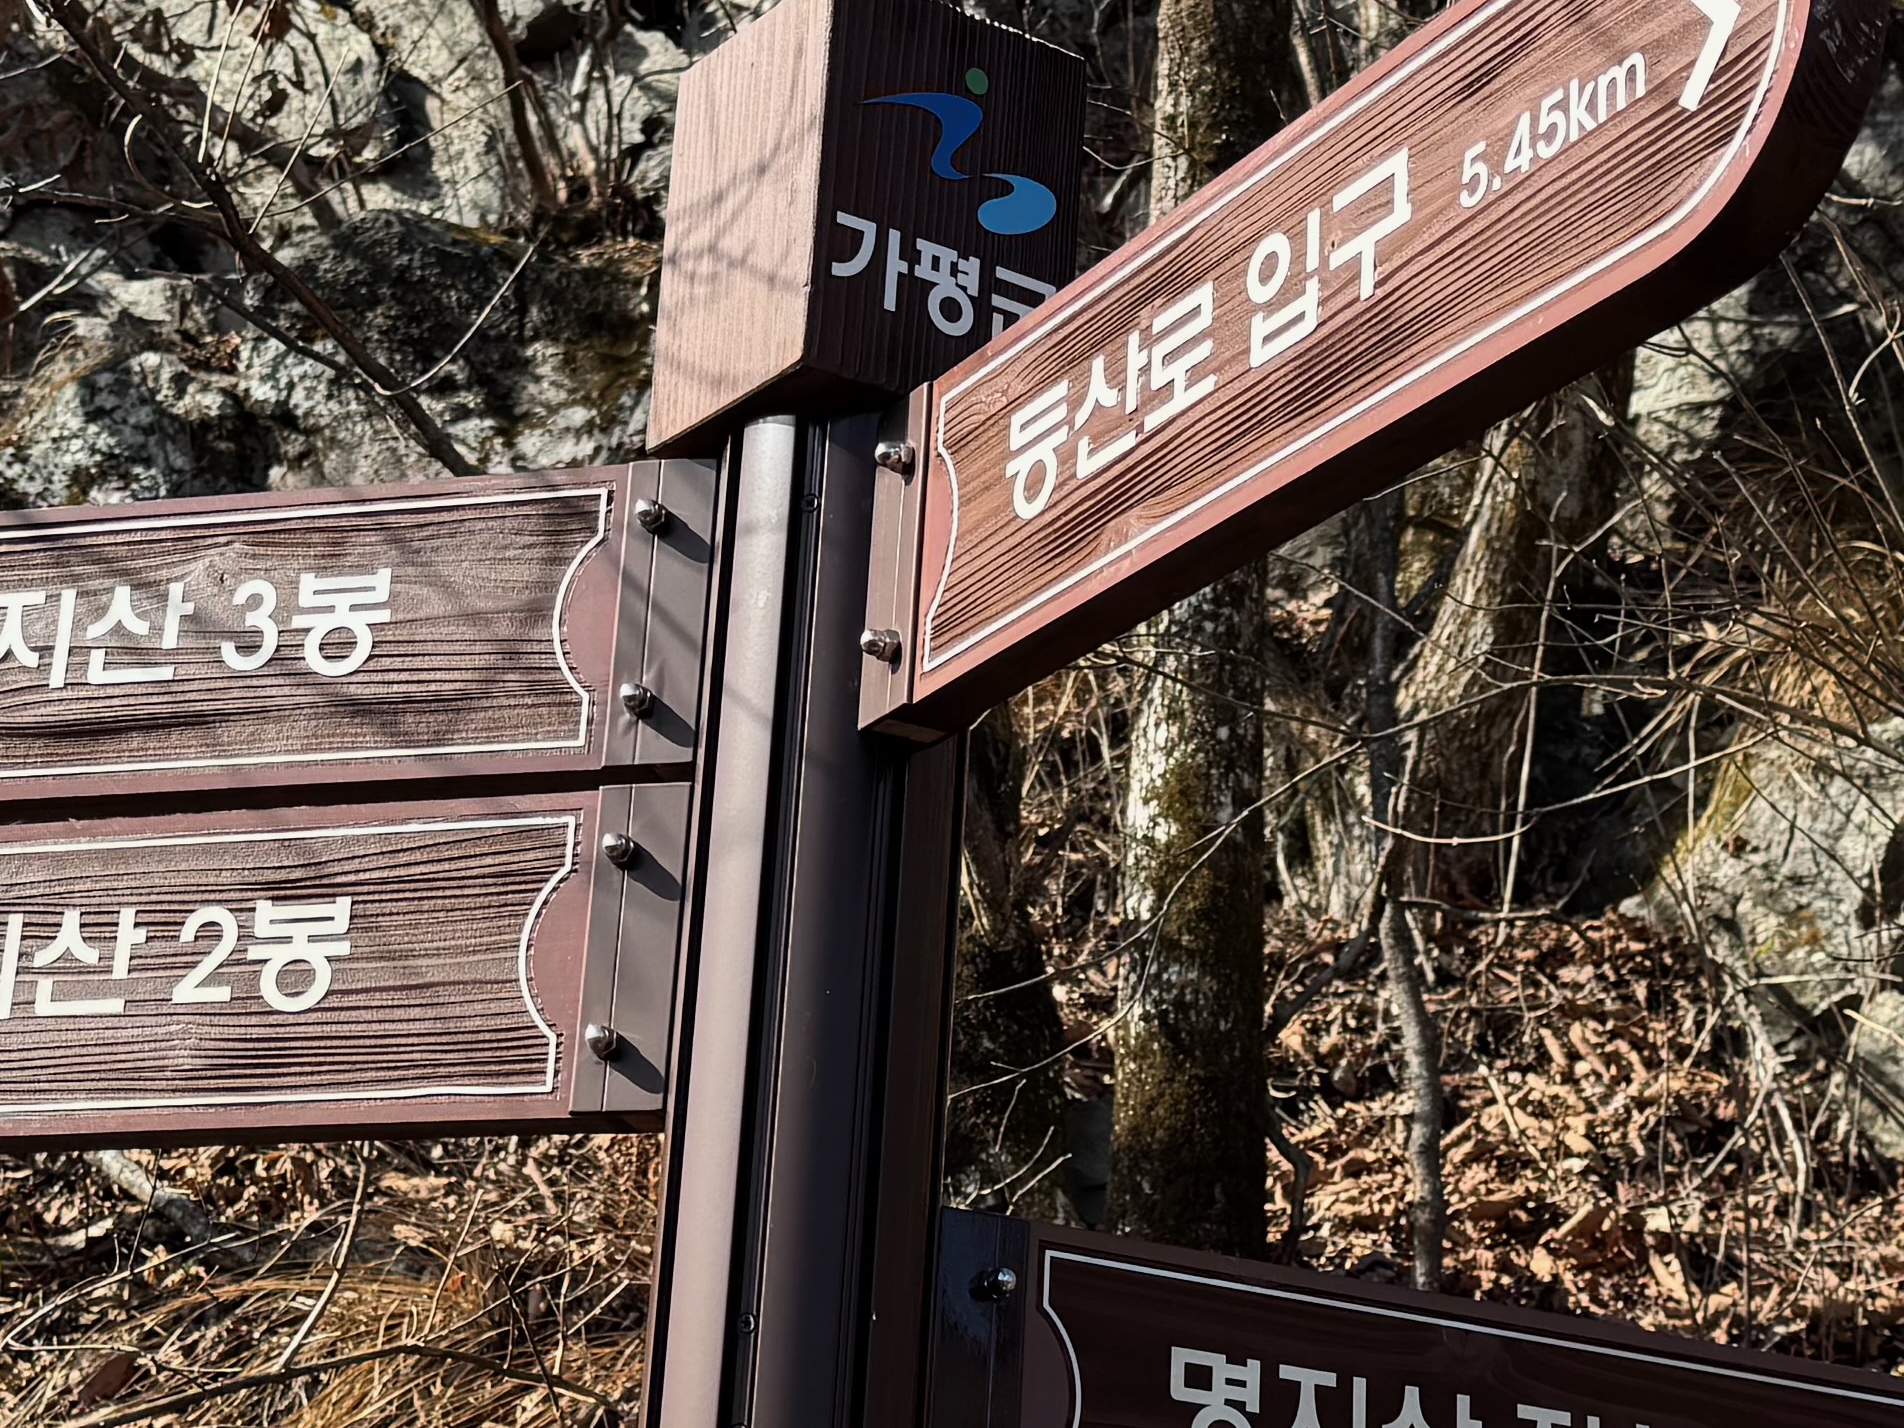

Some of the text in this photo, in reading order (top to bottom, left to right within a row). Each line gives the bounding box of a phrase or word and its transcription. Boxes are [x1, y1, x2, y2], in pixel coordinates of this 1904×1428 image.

[1003, 49, 1647, 522] 등산로 입구 5.45km
[220, 567, 393, 678] 3봉
[171, 896, 354, 1014] 2봉
